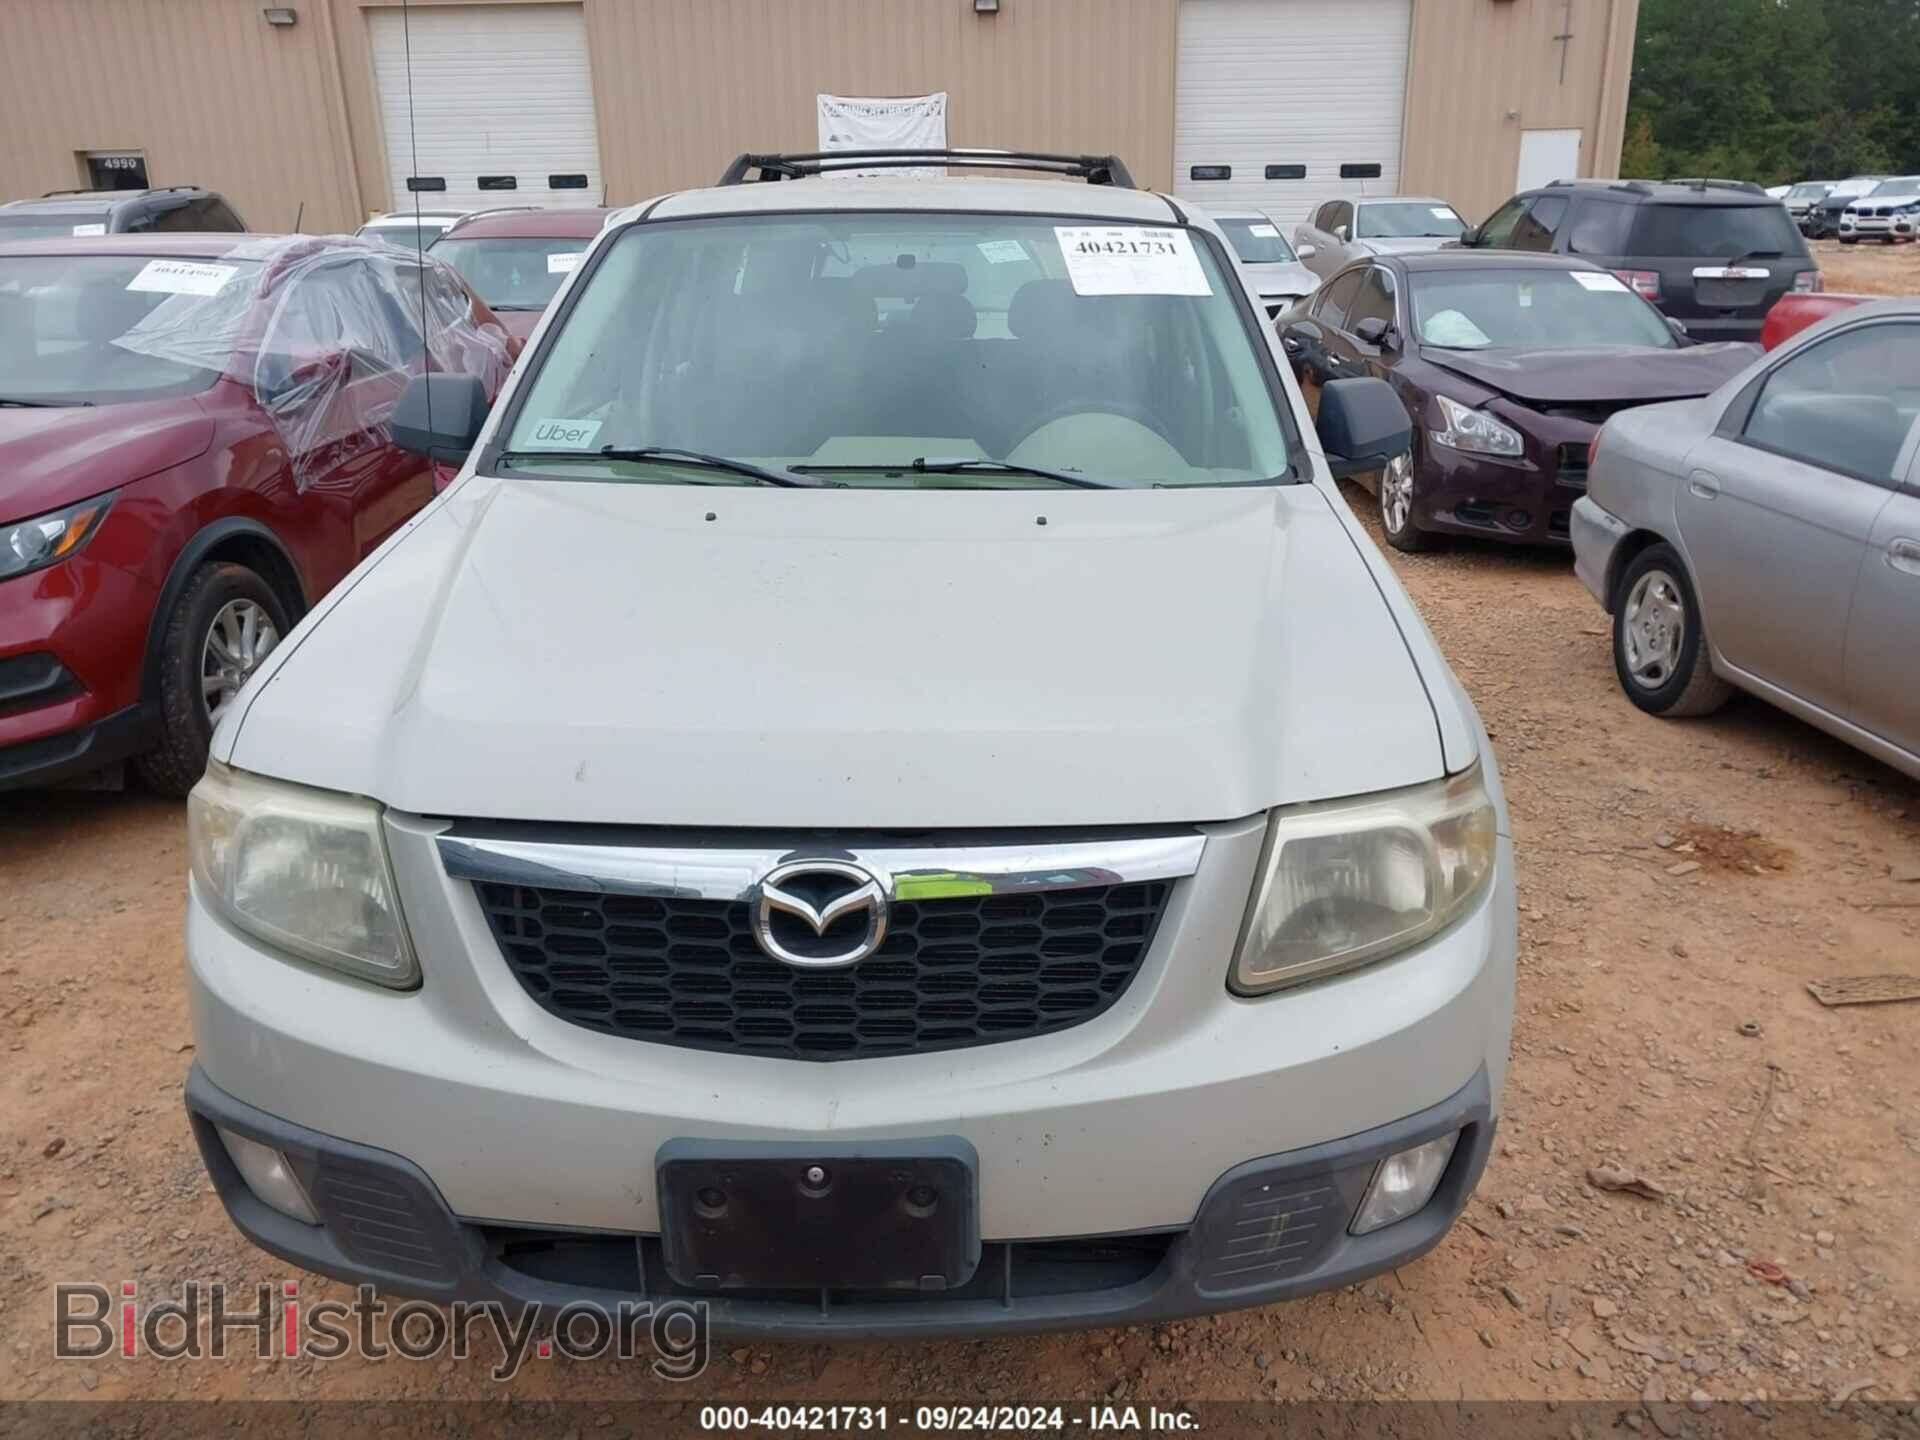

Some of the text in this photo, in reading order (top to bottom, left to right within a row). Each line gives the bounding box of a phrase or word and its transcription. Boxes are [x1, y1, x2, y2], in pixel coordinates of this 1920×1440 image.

[104, 158, 137, 169] 4990
[1075, 240, 1177, 255] 40421731
[535, 424, 591, 442] Uber
